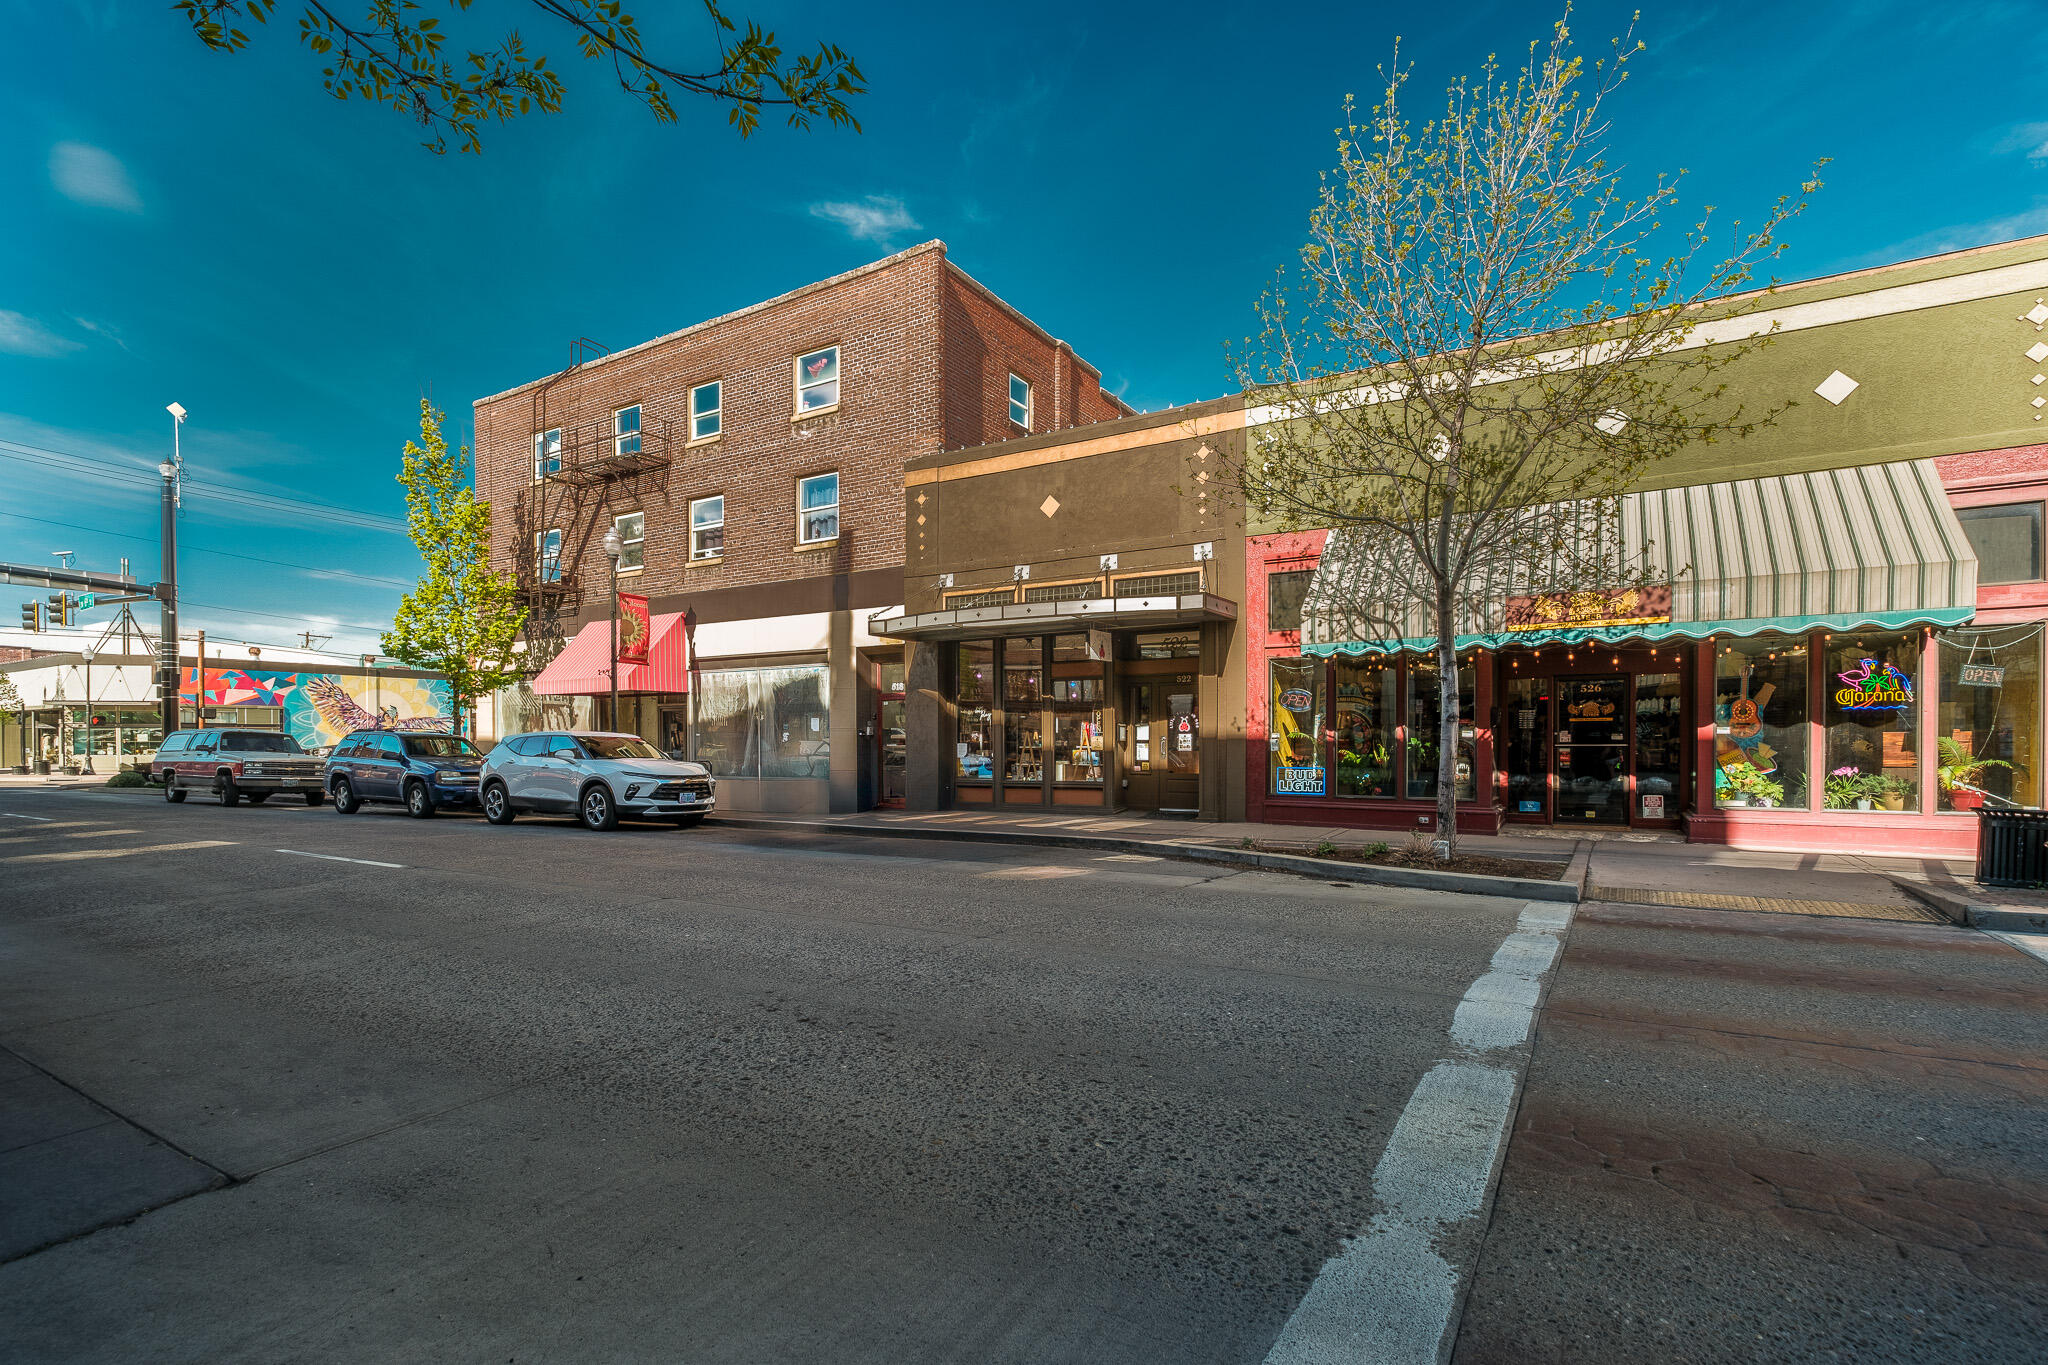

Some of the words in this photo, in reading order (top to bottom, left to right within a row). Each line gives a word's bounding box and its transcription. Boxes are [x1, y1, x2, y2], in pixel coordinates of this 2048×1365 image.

[1176, 675, 1191, 683] 522
[1964, 669, 2000, 683] OPEN
[1581, 684, 1601, 692] 526
[1281, 693, 1312, 706] OPEN
[1836, 689, 1905, 706] Corona
[1285, 770, 1316, 781] BUD
[1280, 780, 1320, 792] LIGHT
